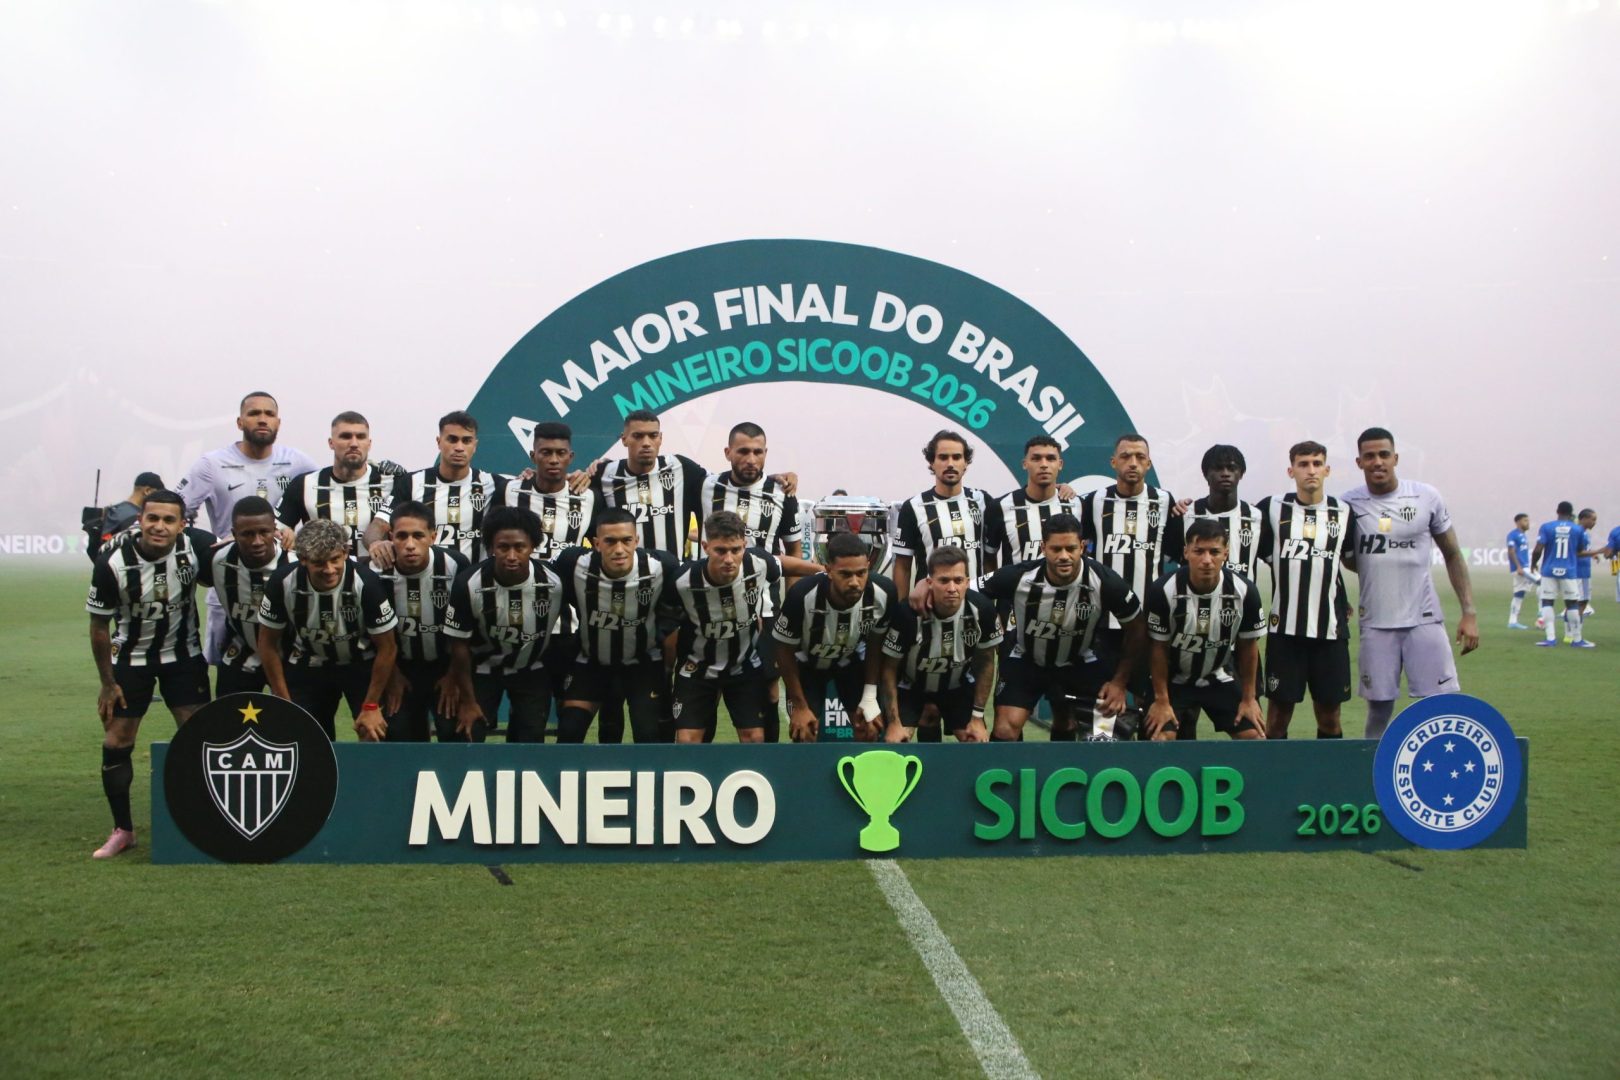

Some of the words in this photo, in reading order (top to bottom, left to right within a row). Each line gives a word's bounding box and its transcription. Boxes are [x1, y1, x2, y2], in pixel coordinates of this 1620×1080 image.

[540, 301, 709, 418] MAIOR
[713, 283, 859, 331] FINAL
[869, 291, 944, 344] DO
[947, 320, 1086, 453] BRASIL
[612, 340, 772, 421] MINEIRO
[776, 338, 914, 387] SICOOB
[910, 363, 997, 430] 2026
[1555, 537, 1569, 559] 11
[218, 753, 283, 769] CAM
[1407, 720, 1492, 753] CRUZEIRO
[408, 769, 776, 845] MINEIRO
[973, 766, 1245, 840] SICOOB
[1296, 803, 1382, 836] 2026
[1398, 764, 1455, 827] ESPORTE
[1463, 764, 1498, 821] CLUBE
